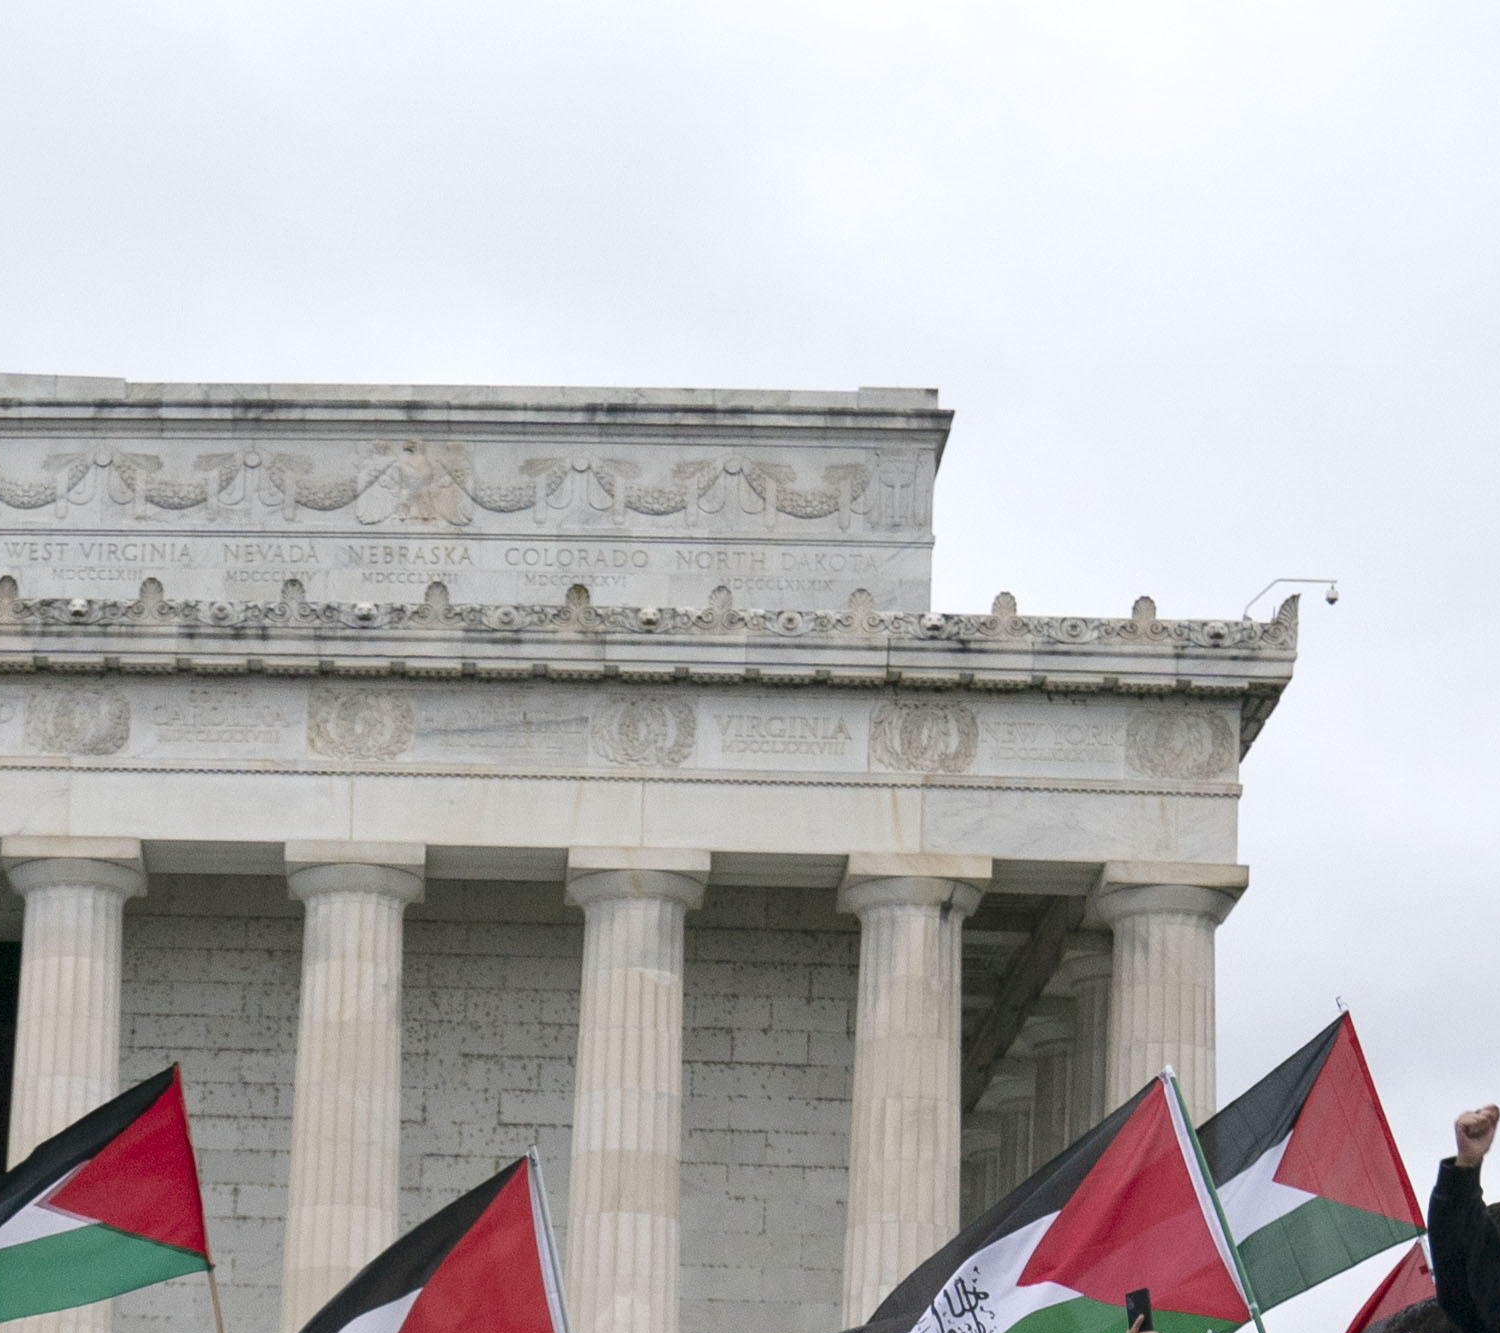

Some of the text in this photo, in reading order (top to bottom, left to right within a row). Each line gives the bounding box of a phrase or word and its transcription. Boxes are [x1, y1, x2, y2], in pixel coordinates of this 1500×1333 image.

[3, 542, 191, 563] WEST VIRGINIA
[224, 545, 319, 565] NEVADA
[348, 545, 474, 566] NEBRASKA
[505, 547, 649, 569] COLORADO
[676, 550, 881, 573] NORTH DAKOTA
[713, 715, 852, 741] VIRGINIA
[982, 721, 1124, 747] NEW YORK
